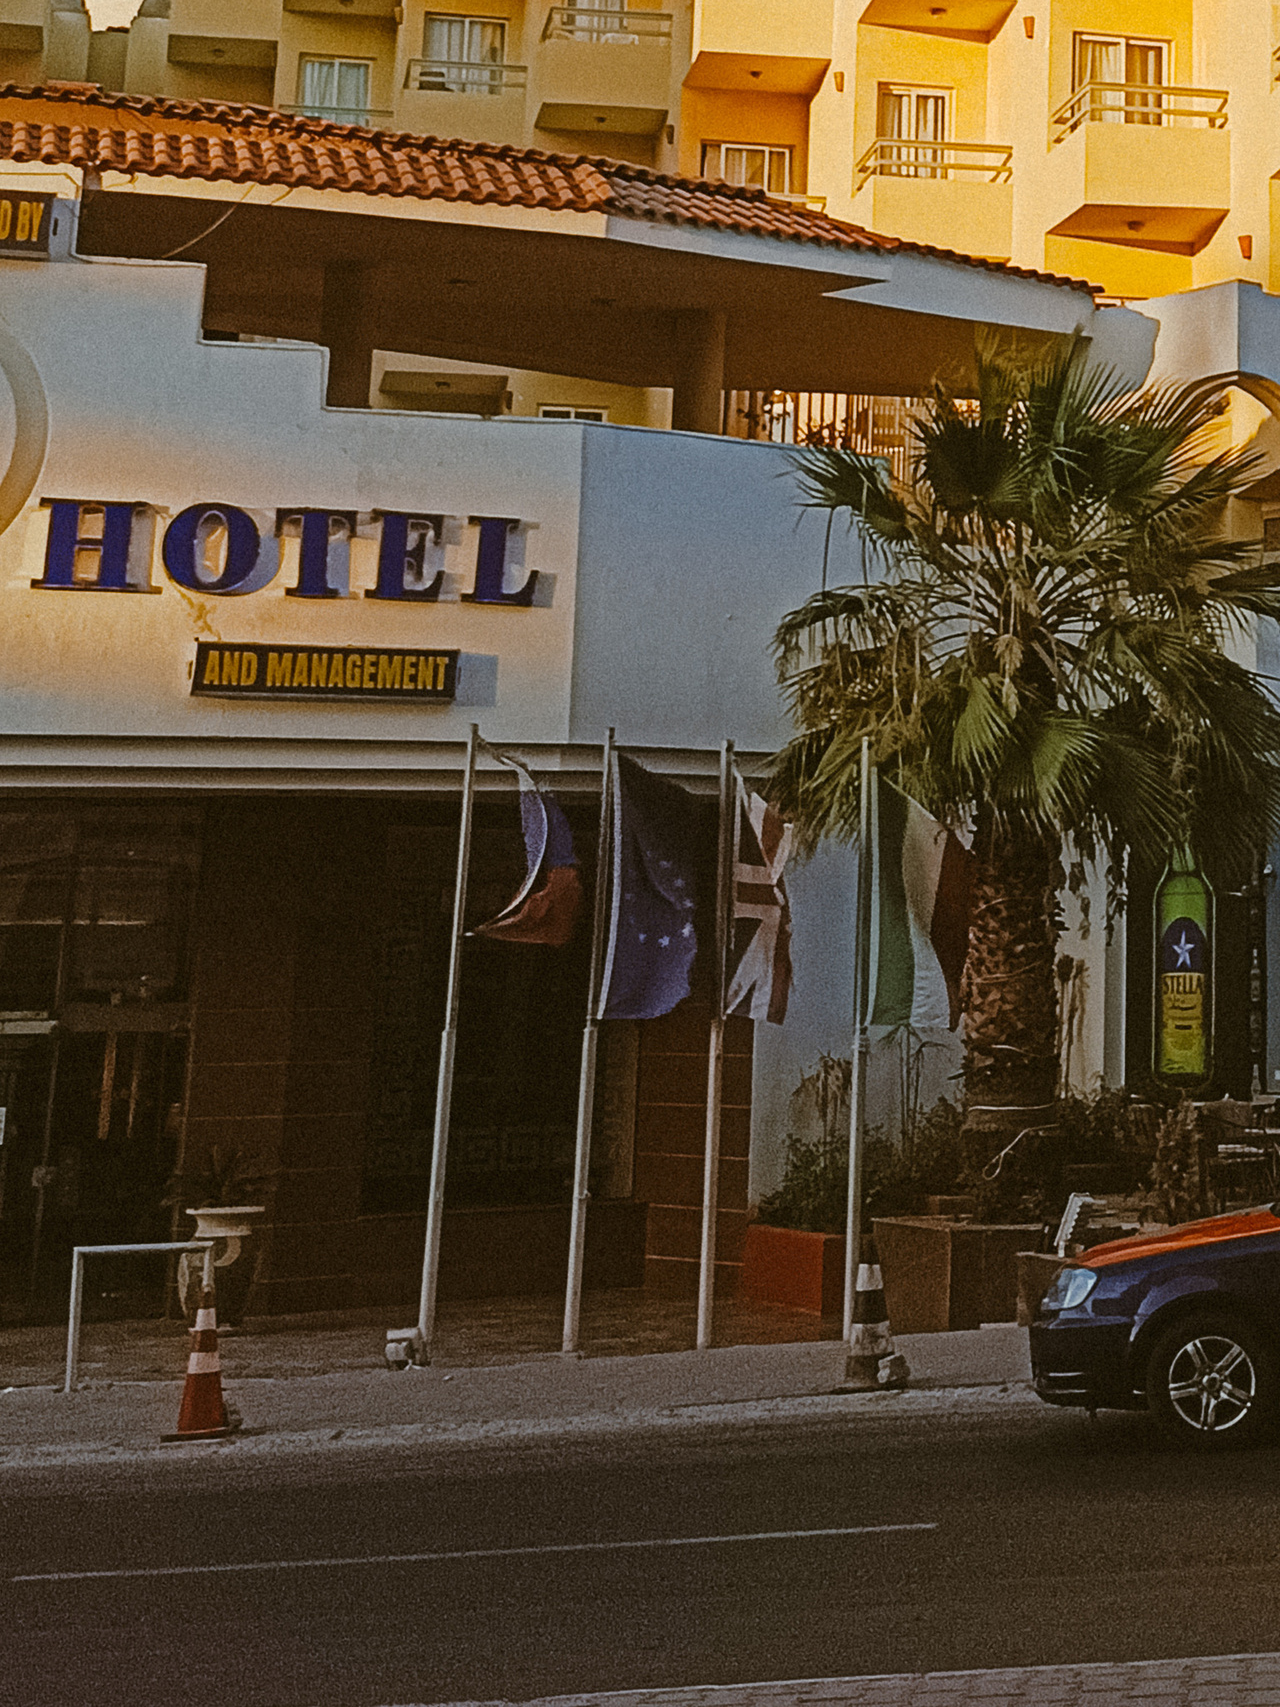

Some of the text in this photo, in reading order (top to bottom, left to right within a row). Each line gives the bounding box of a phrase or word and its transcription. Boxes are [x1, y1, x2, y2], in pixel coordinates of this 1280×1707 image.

[16, 200, 45, 242] BY
[30, 497, 541, 608] HOTEL
[203, 650, 449, 690] AND MANAGEMENT
